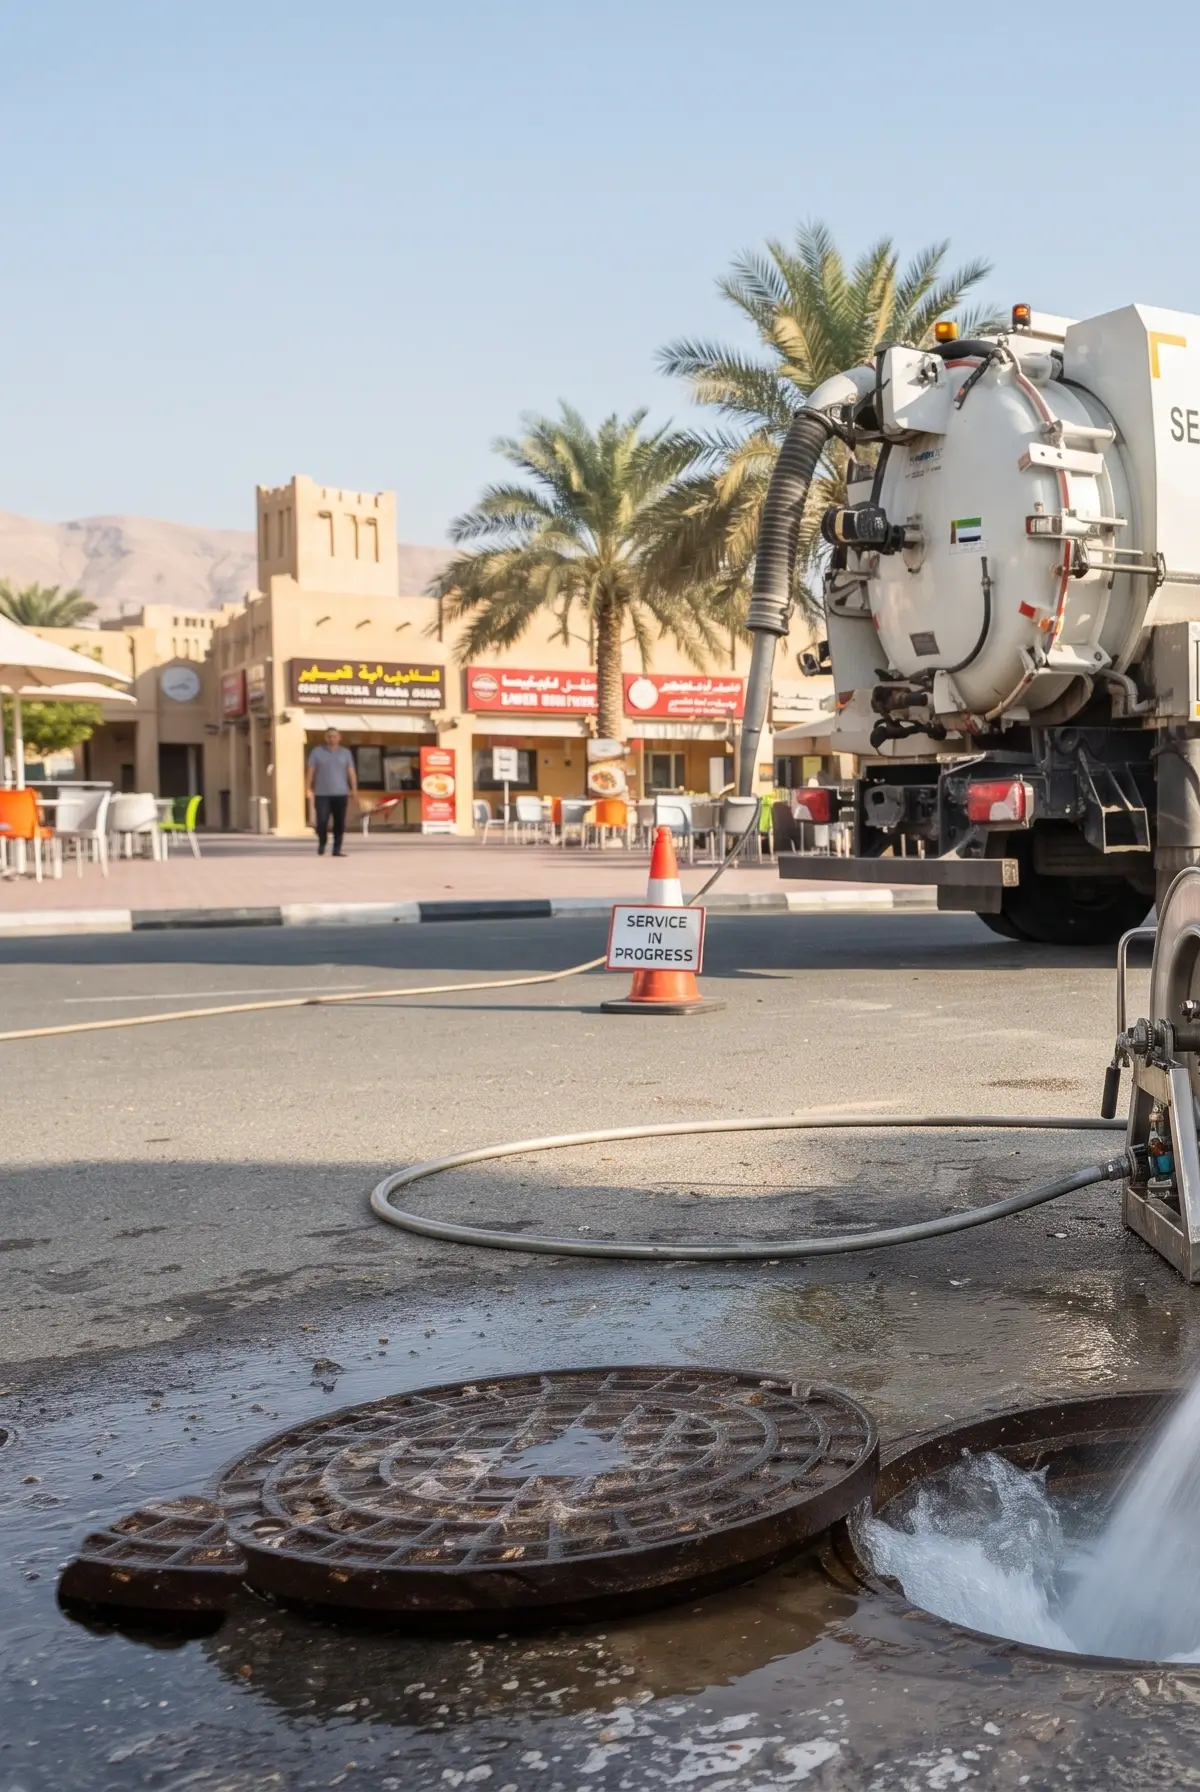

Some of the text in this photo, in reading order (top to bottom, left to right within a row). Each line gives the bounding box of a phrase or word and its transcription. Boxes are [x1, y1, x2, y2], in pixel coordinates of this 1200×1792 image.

[627, 915, 688, 929] SERVICE
[647, 932, 662, 945] IN
[615, 947, 693, 962] PROGRESS
